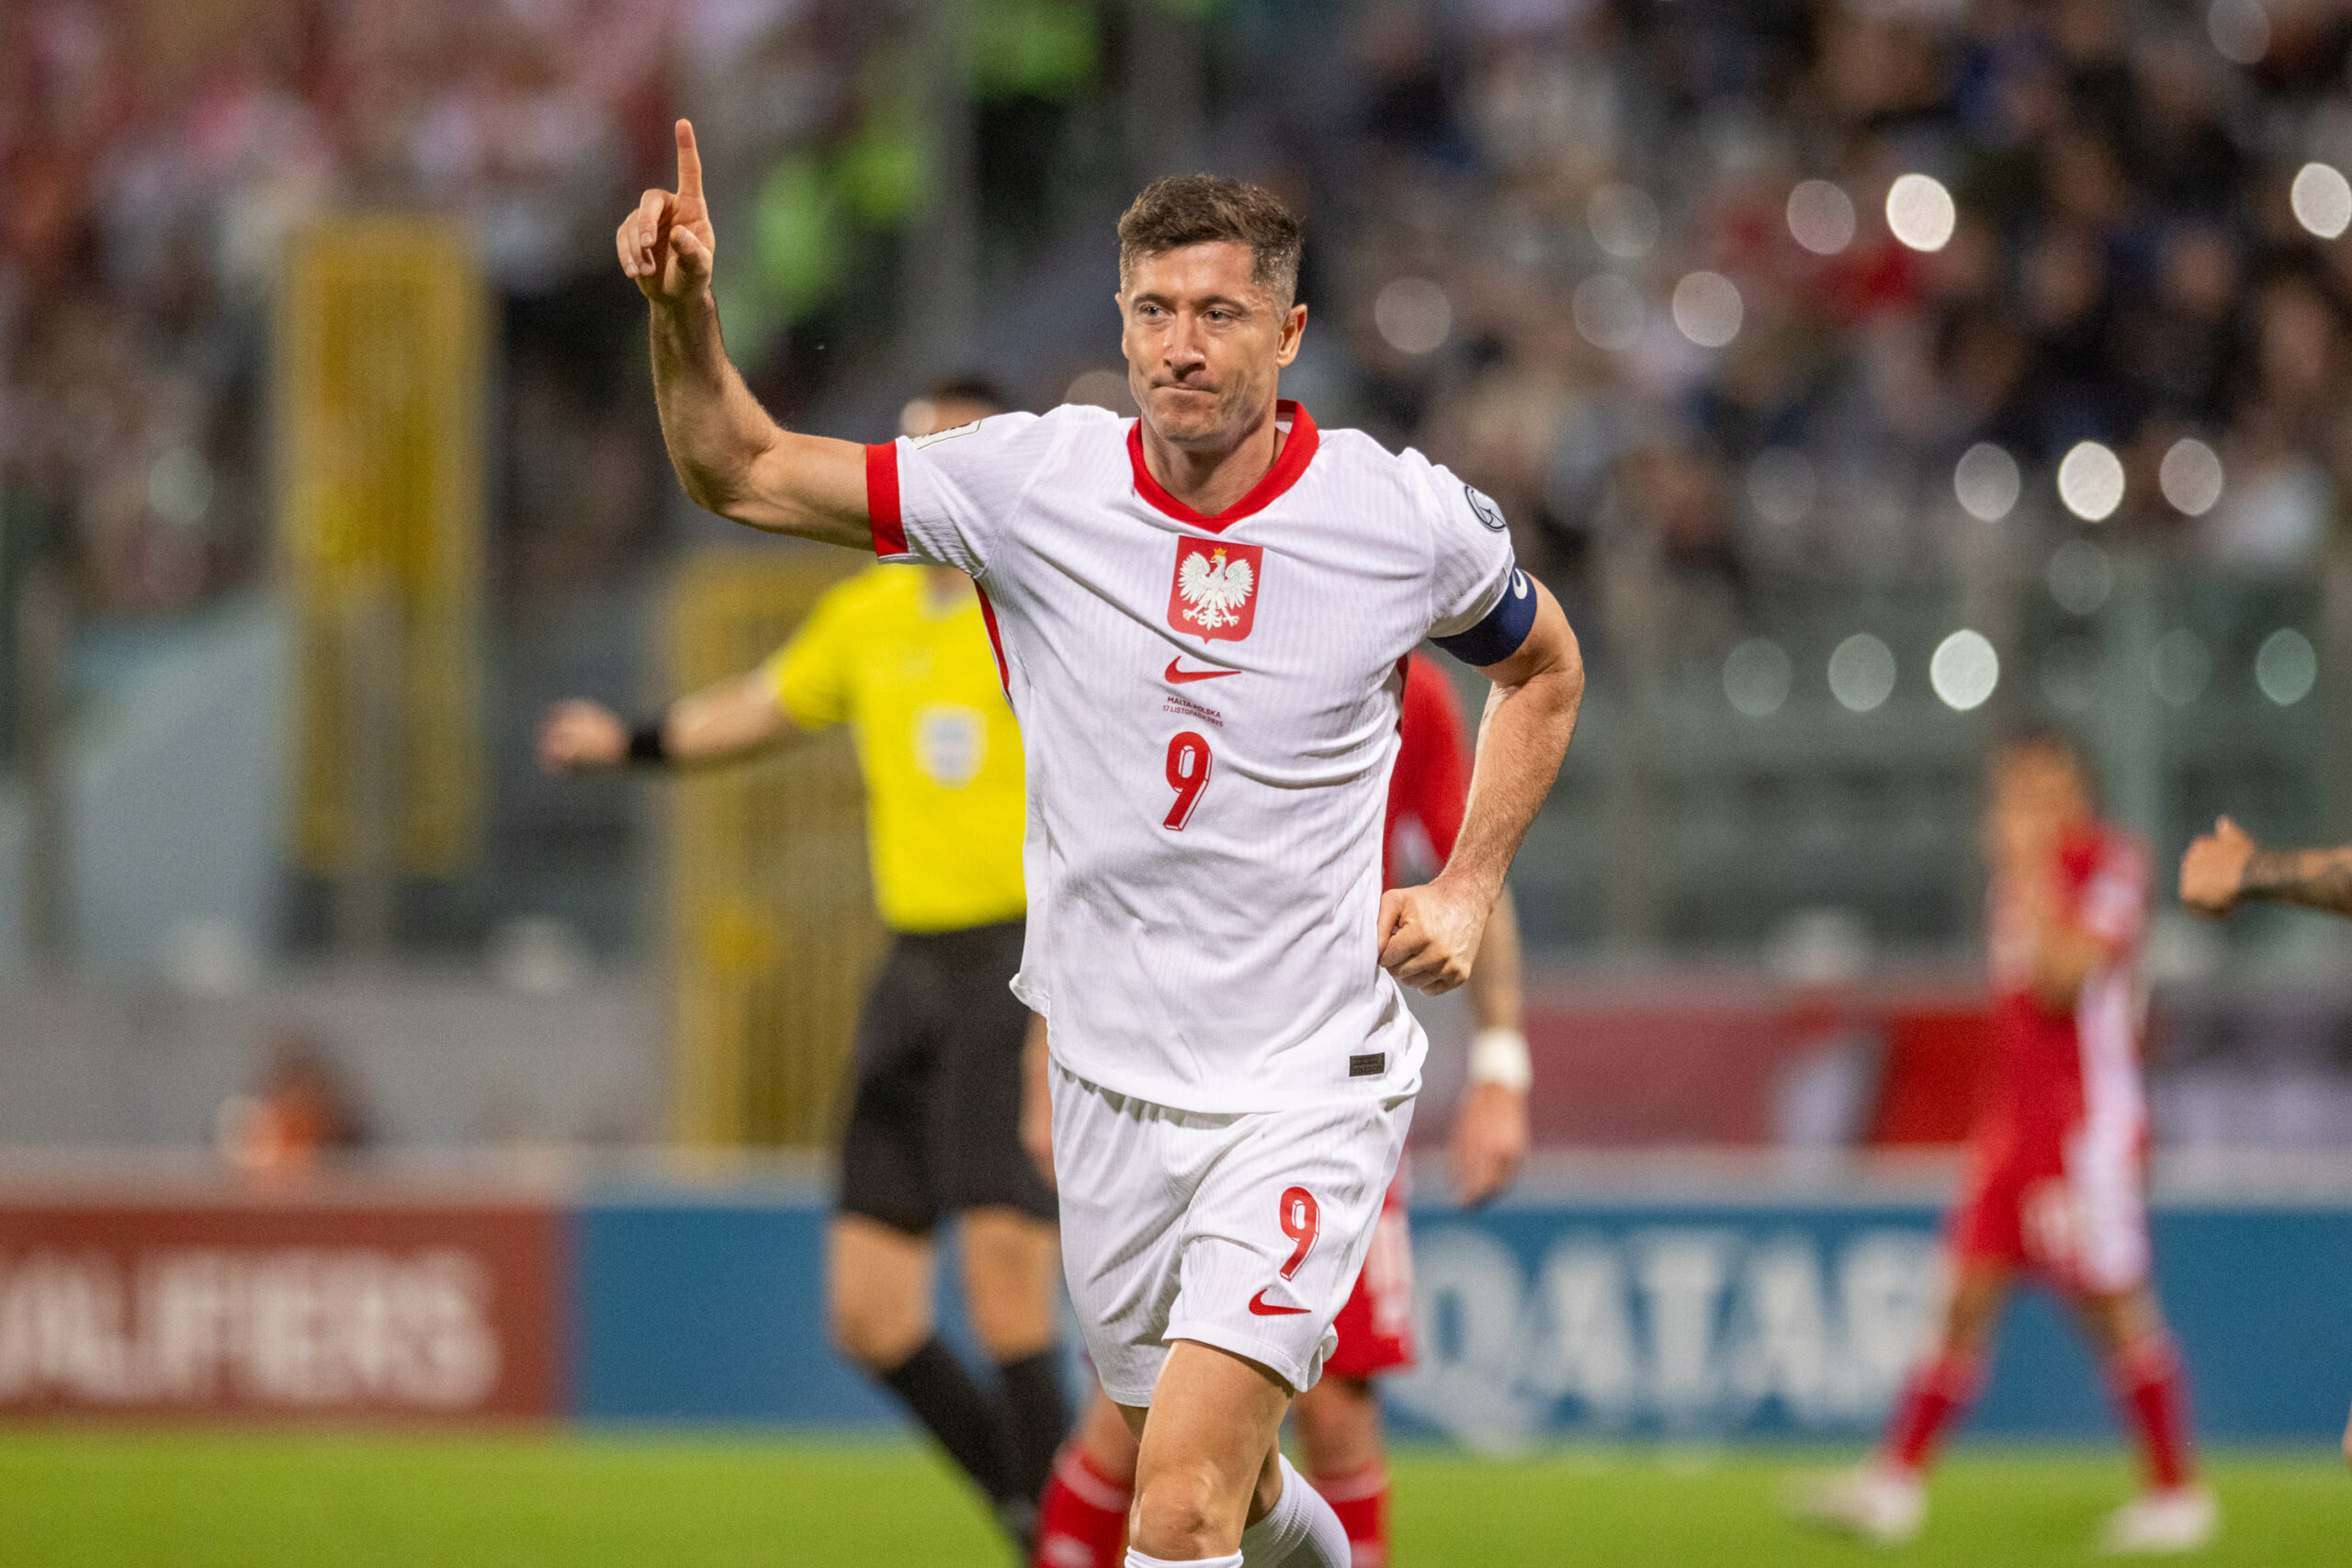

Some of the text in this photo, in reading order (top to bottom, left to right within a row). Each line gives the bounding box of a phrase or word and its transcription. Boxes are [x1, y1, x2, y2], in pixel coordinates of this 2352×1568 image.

[1170, 706, 1206, 720] LISTOPADA
[1206, 716, 1224, 728] 2025
[1162, 731, 1213, 832] 9
[1279, 1186, 1321, 1281] 9
